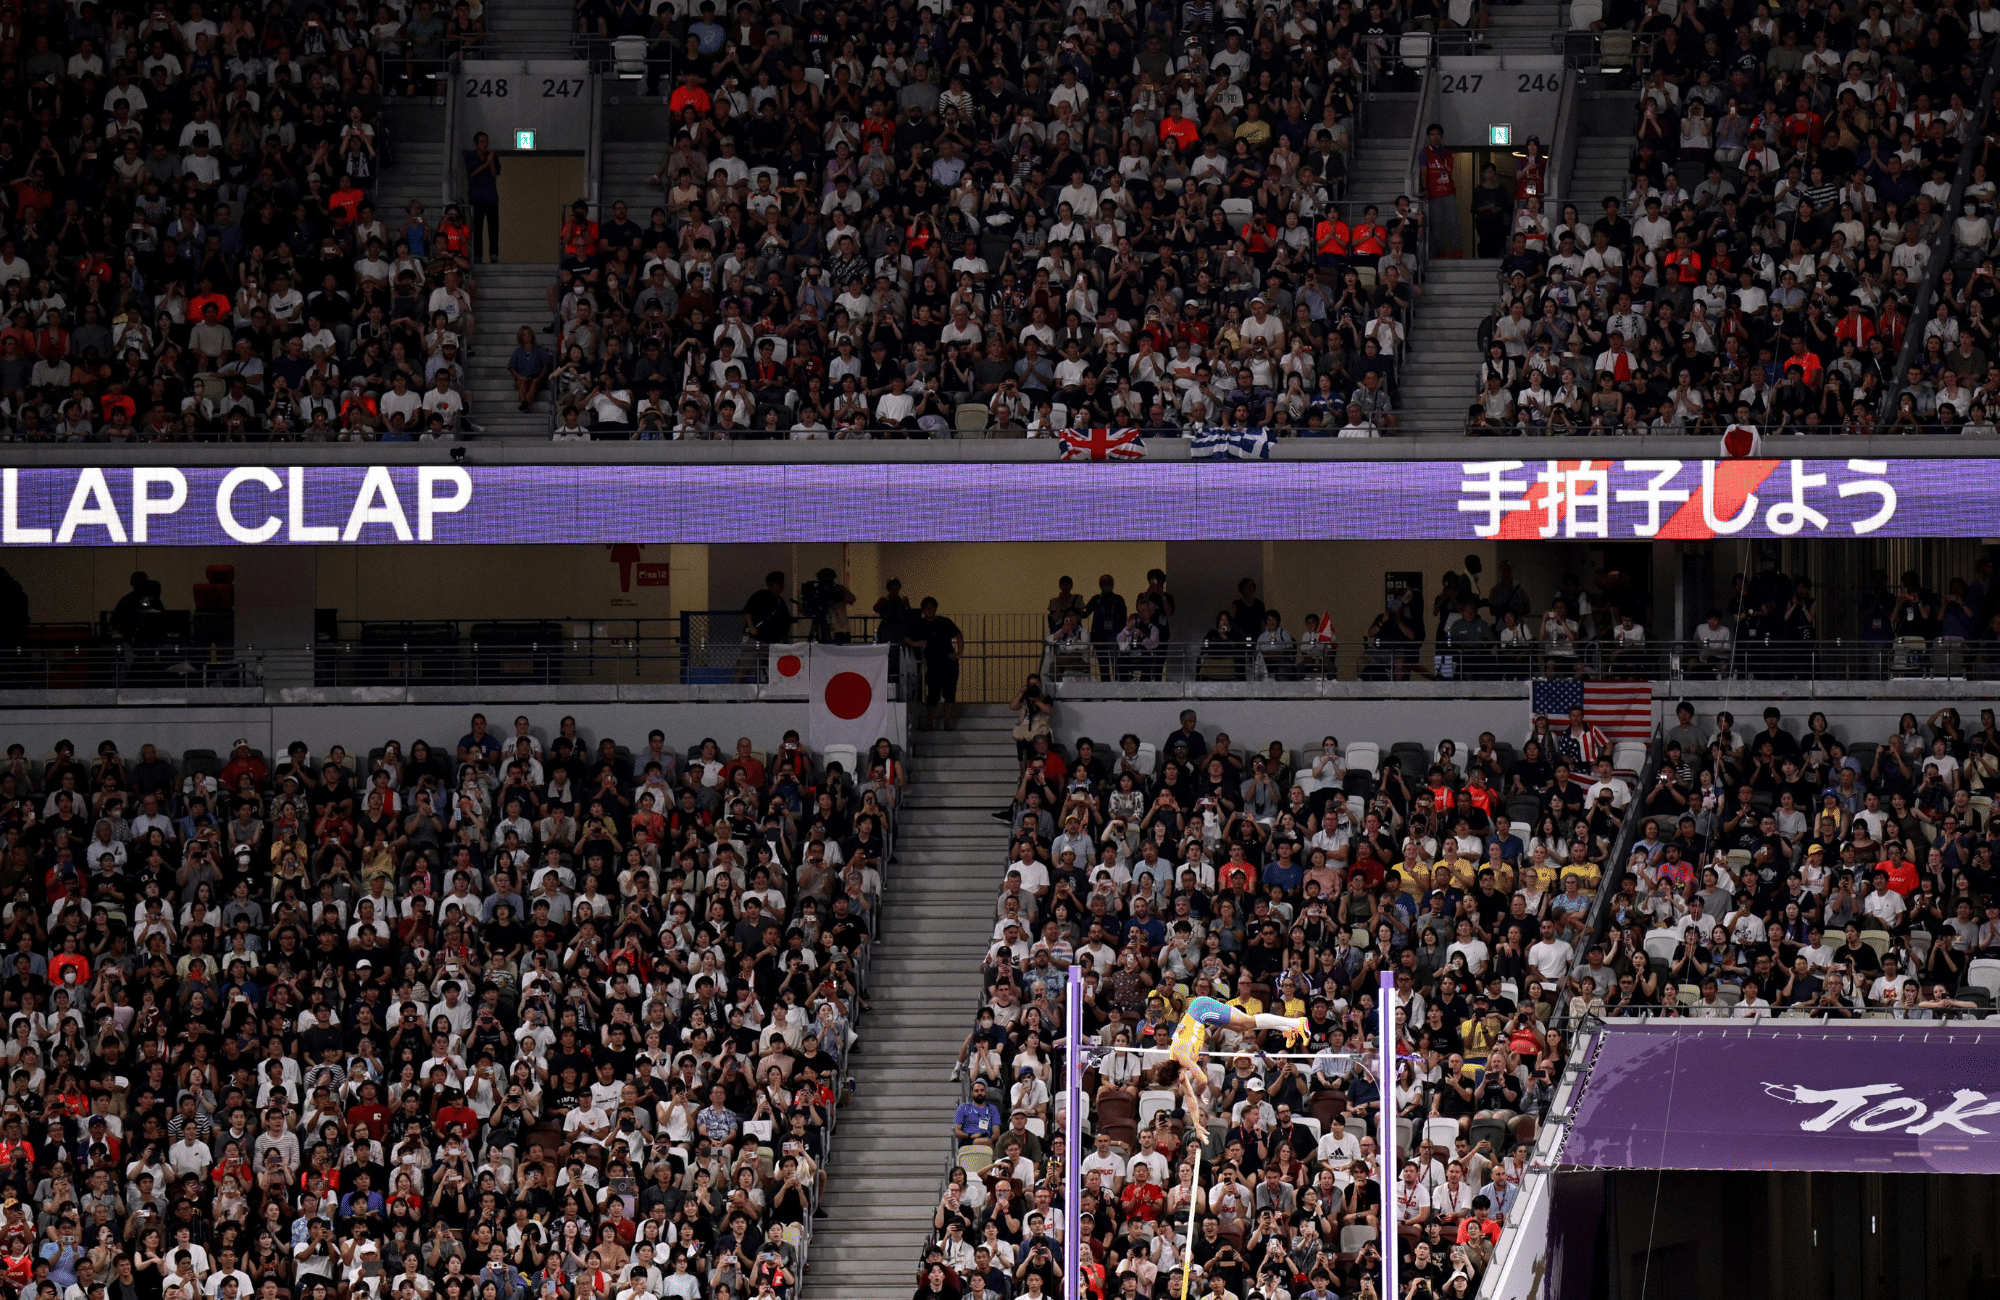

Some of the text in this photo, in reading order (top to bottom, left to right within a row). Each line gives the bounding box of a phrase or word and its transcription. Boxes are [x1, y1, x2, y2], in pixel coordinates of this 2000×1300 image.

[466, 79, 508, 98] 248
[542, 79, 584, 98] 247
[1442, 75, 1483, 93] 247
[1518, 74, 1559, 93] 246
[217, 466, 472, 542] CLAP
[1457, 460, 1897, 538] 手拍子しよう
